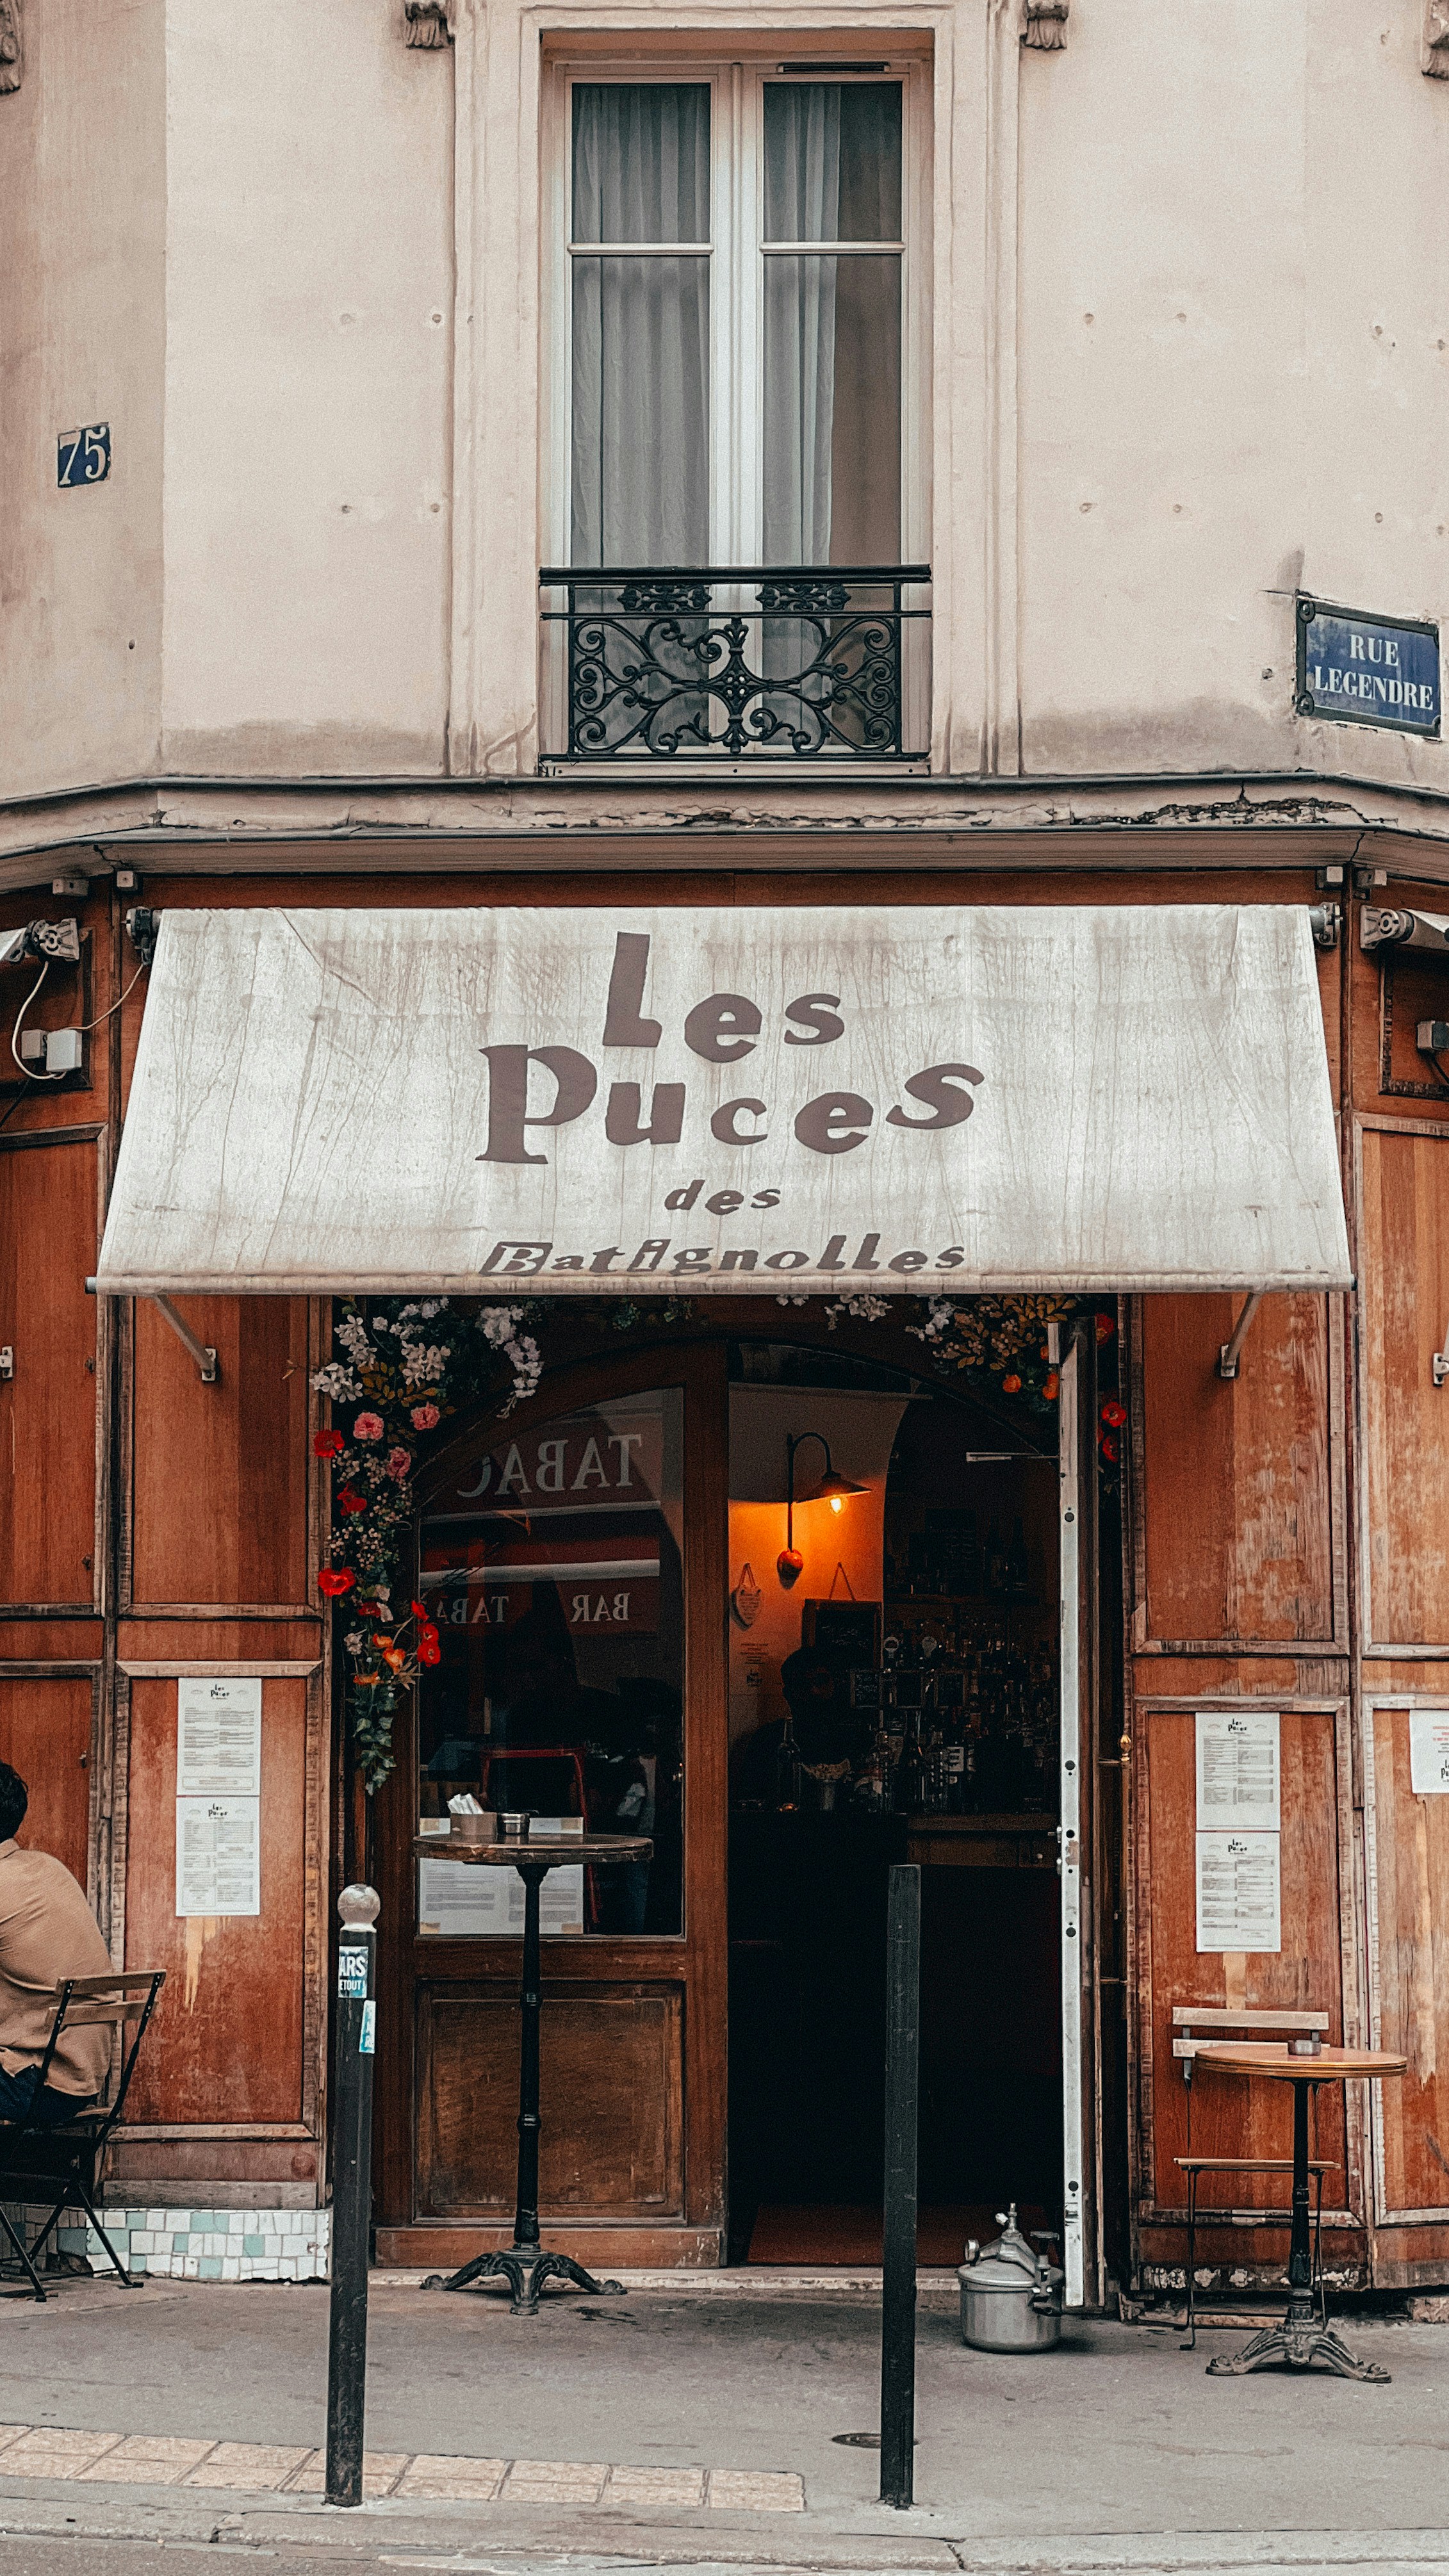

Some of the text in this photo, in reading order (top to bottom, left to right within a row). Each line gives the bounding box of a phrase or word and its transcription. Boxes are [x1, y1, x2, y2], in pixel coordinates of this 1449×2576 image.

[59, 427, 106, 485] 75
[1350, 634, 1399, 665] RUE
[1314, 665, 1434, 711] LEGENDRE
[602, 931, 845, 1063] Les
[475, 1044, 985, 1164] Puces
[664, 1179, 781, 1215] des
[480, 1233, 965, 1276] Batignolles
